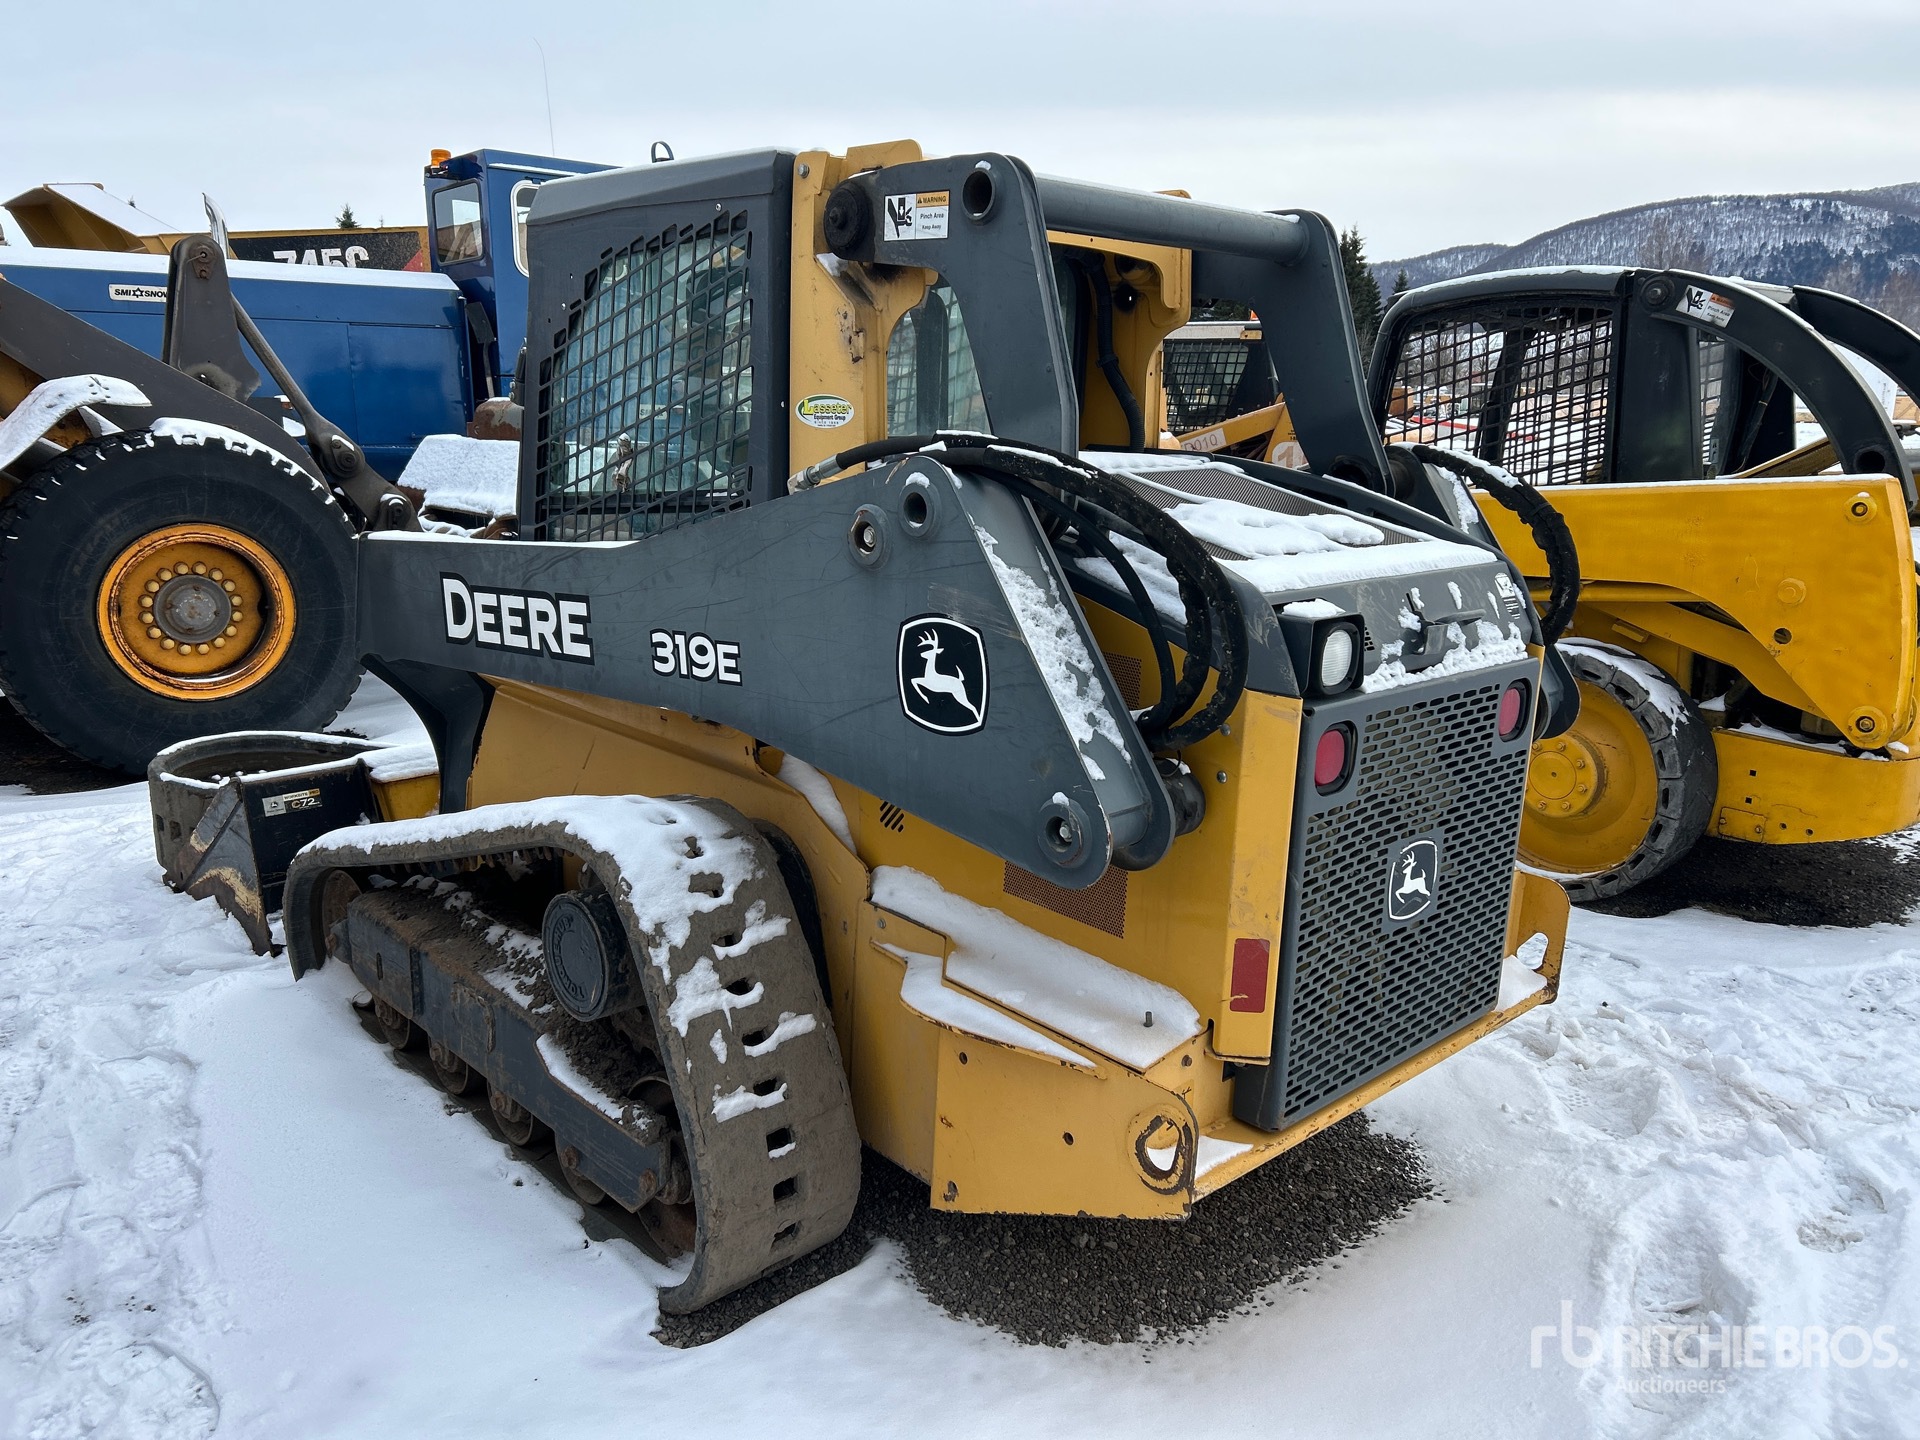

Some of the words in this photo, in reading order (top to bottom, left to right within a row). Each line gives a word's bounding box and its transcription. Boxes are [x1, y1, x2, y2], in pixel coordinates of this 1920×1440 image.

[922, 195, 947, 204] WARNING
[920, 212, 933, 220] Pinch
[114, 288, 132, 296] SMI
[803, 399, 852, 415] Lasseter
[442, 576, 592, 660] DEERE
[650, 630, 742, 684] 319E
